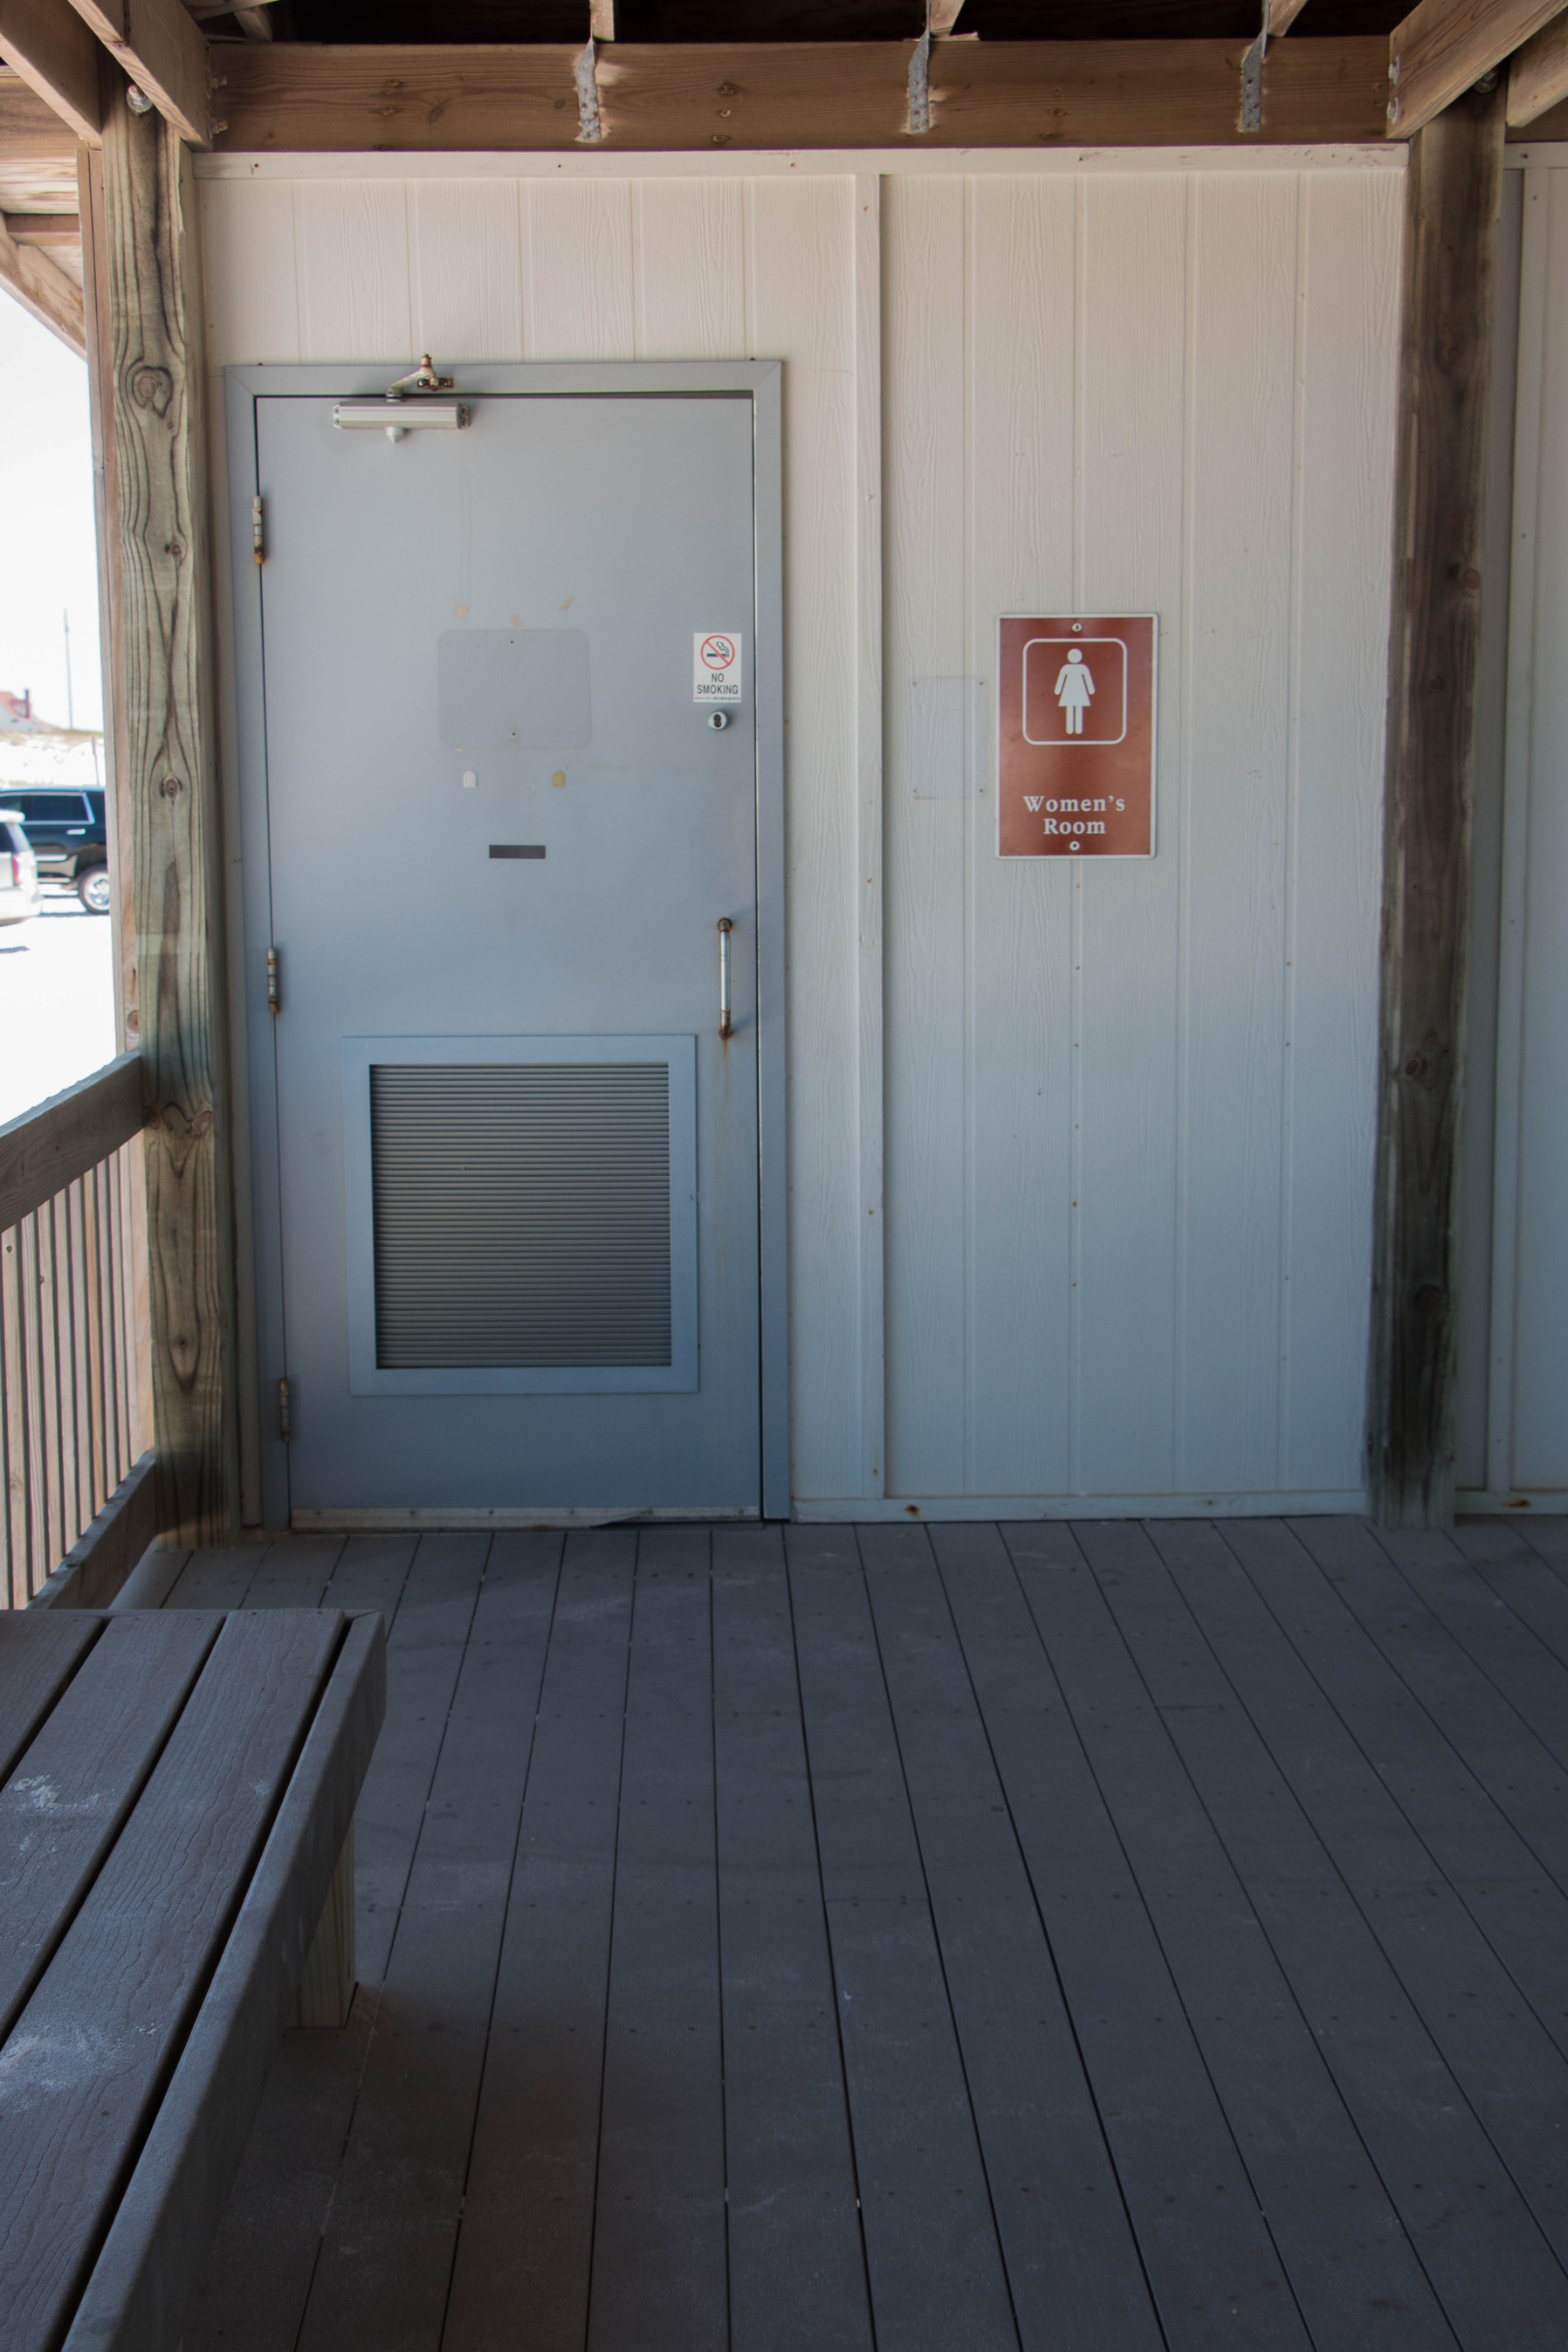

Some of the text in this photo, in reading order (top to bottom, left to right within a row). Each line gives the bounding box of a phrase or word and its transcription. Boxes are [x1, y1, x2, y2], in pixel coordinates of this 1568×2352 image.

[711, 672, 725, 683] NO
[697, 684, 739, 694] SMOKING
[1022, 795, 1125, 813] Women's
[1042, 818, 1106, 835] Room
